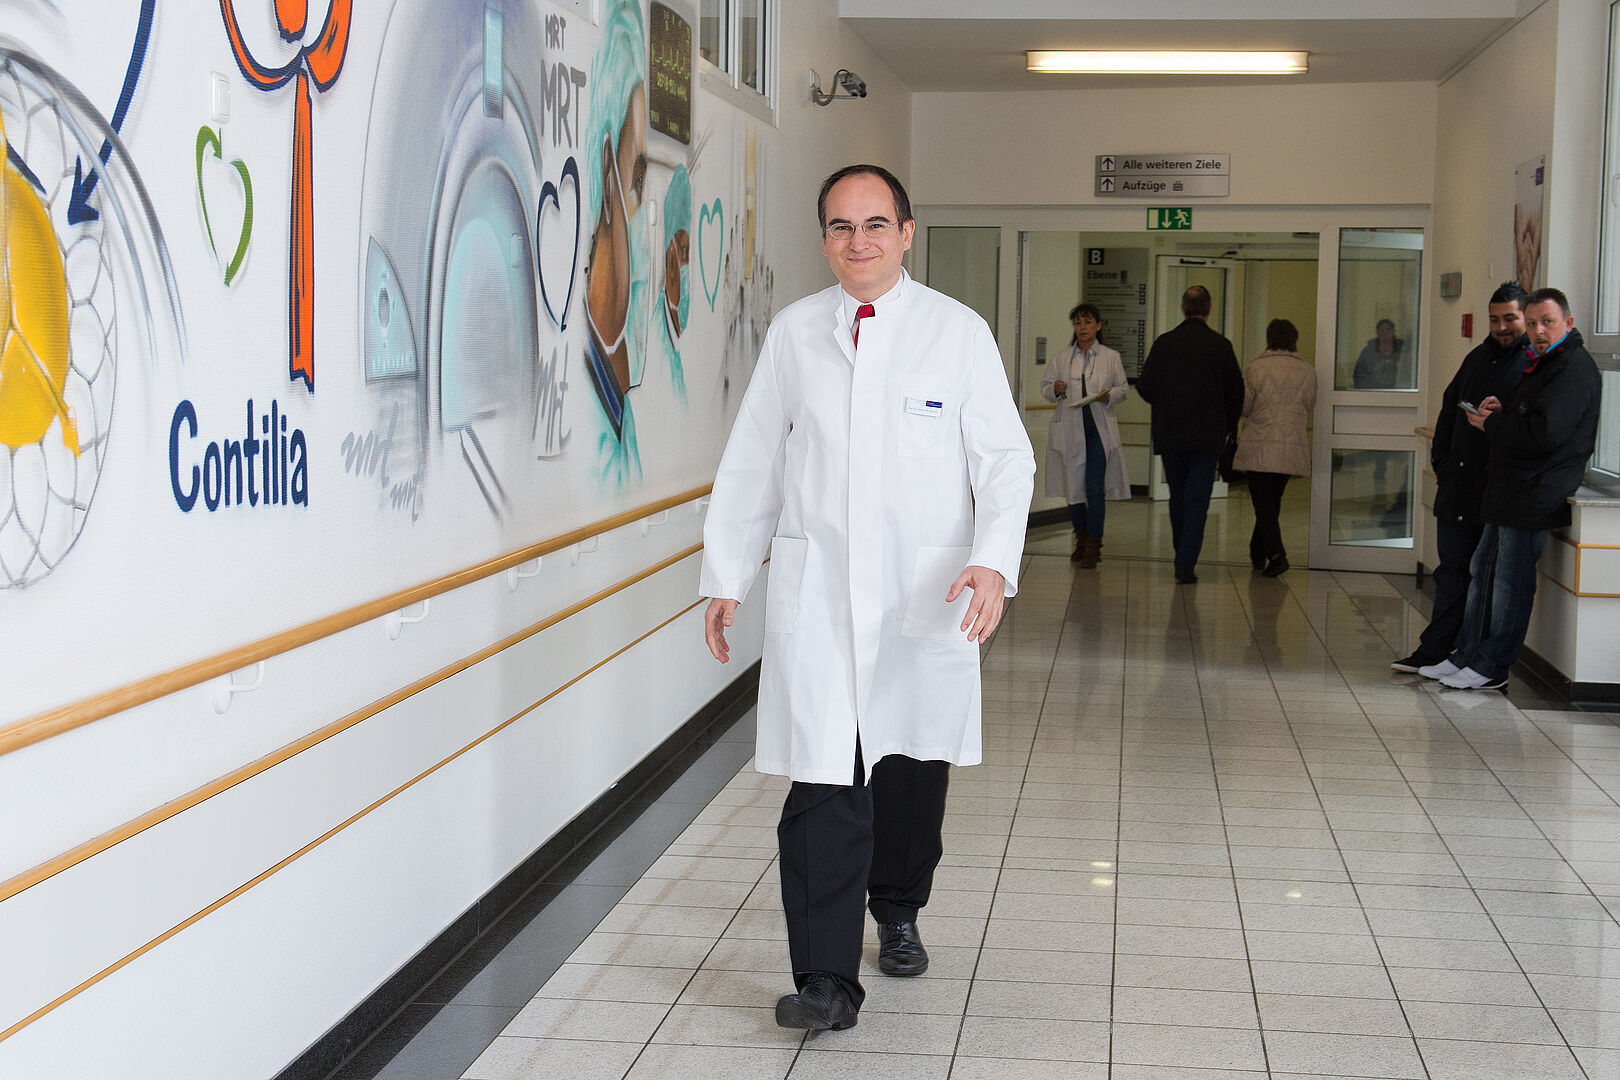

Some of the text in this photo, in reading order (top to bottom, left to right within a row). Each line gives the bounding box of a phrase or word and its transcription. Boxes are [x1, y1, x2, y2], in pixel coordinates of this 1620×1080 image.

[545, 13, 567, 50] MRT
[540, 59, 587, 149] MRT
[1122, 159, 1222, 170] Alle weiteren Ziele
[1122, 180, 1167, 193] Aufzüge
[1091, 249, 1102, 264] B
[1087, 270, 1119, 280] Ebene
[169, 398, 309, 513] Contilia
